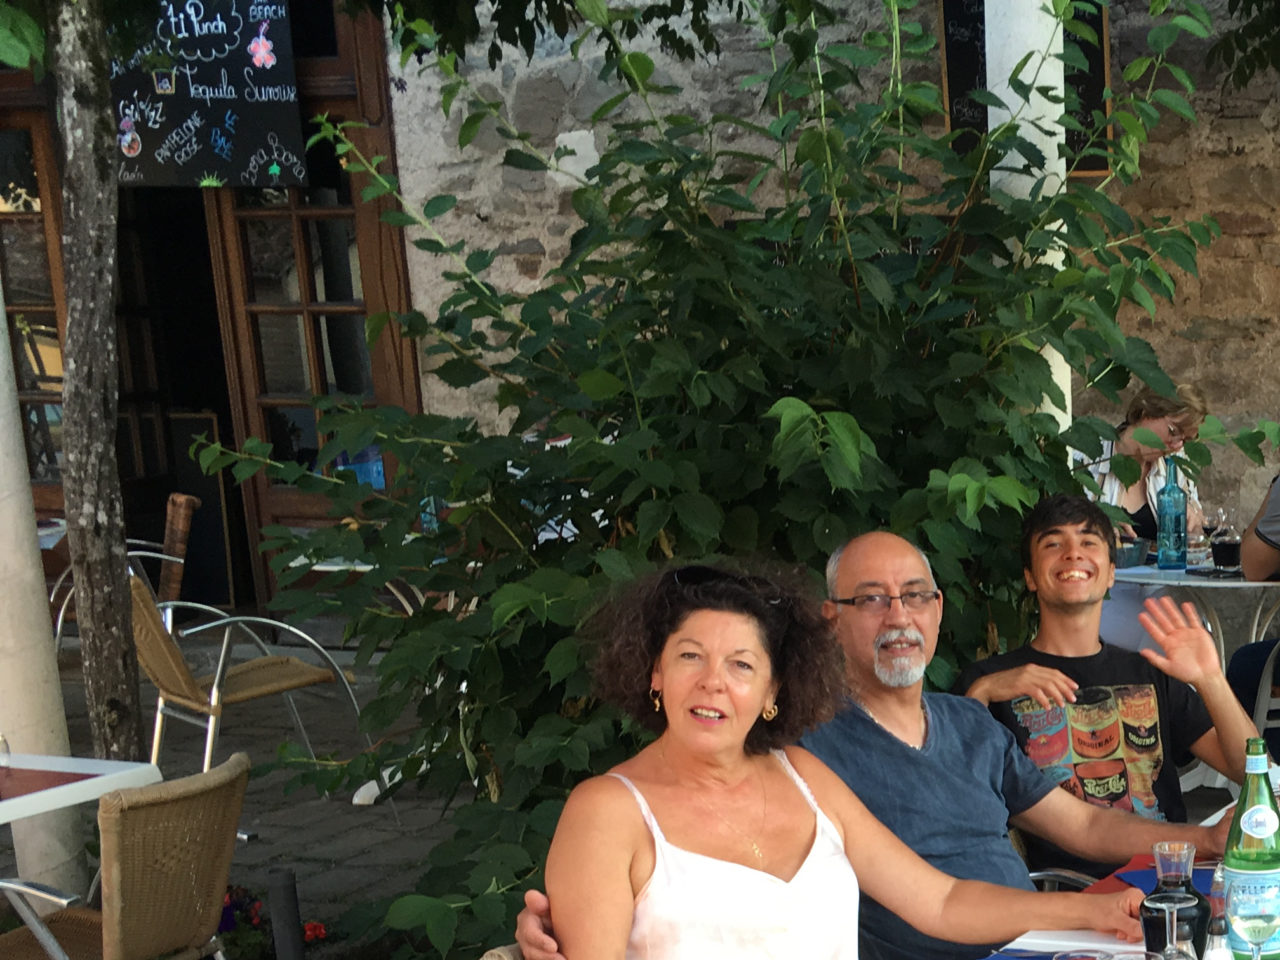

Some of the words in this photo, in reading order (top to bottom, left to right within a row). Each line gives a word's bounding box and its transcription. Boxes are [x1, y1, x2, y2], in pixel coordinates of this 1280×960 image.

[186, 0, 227, 38] Punch
[249, 4, 286, 22] BEACH
[179, 63, 238, 107] Tequila
[244, 66, 298, 102] Sunrise
